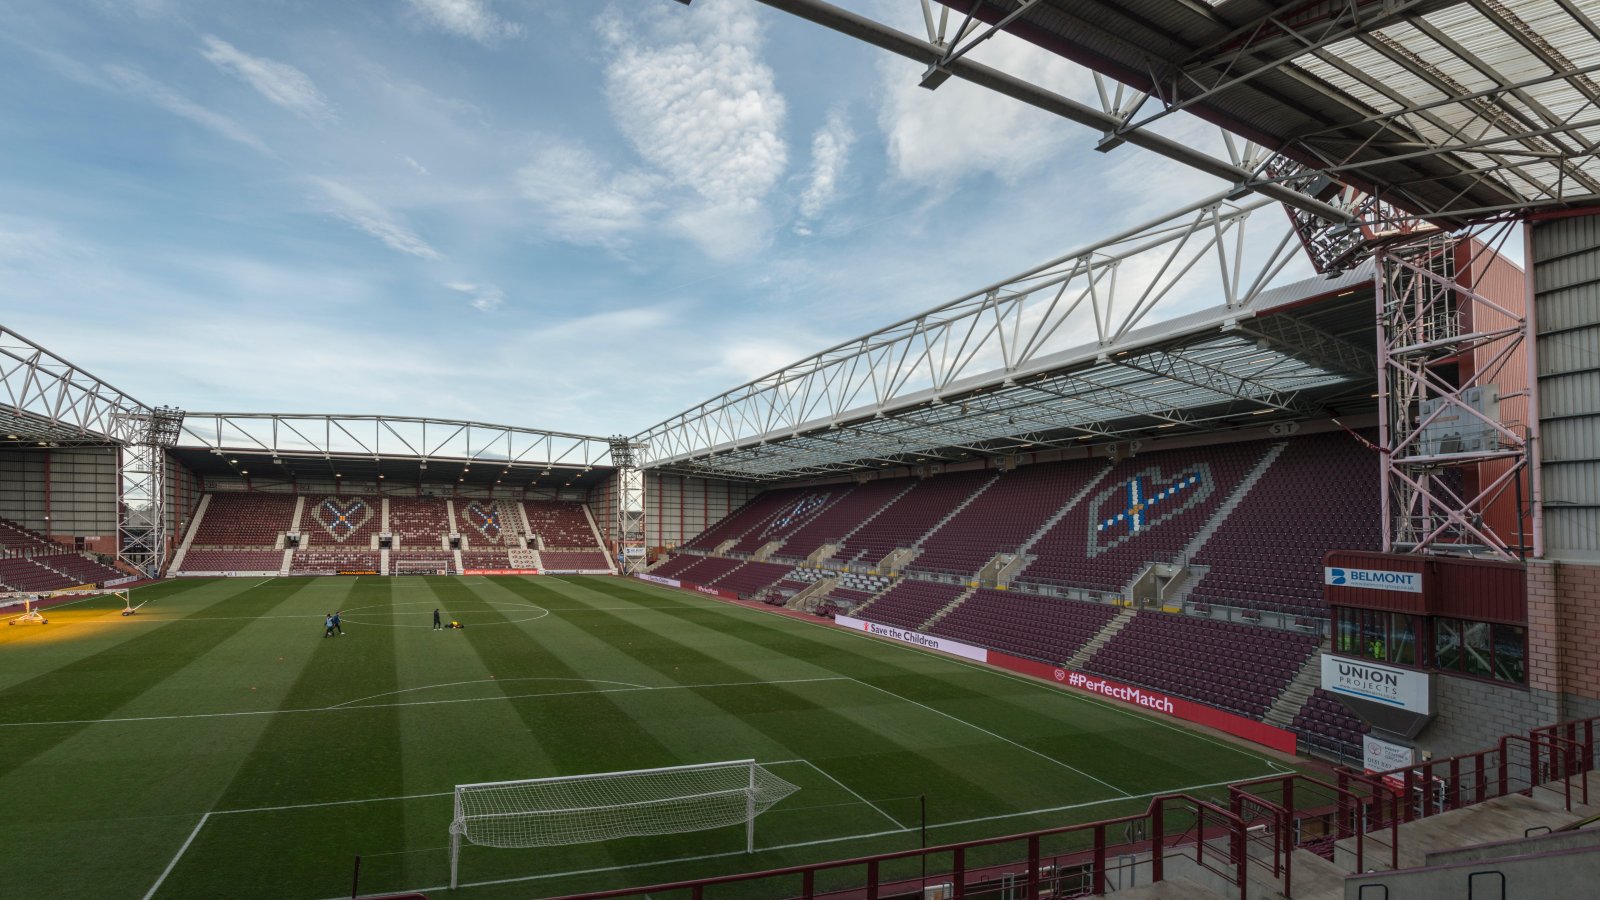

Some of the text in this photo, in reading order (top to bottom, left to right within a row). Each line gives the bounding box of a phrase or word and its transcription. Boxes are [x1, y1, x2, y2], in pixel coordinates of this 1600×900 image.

[1274, 423, 1294, 434] S T
[1350, 571, 1413, 584] BELMONT
[871, 623, 939, 649] Save the Children
[1339, 663, 1398, 687] UNION
[1339, 676, 1398, 696] PROJECTS
[1069, 672, 1173, 713] #PerfectMatch
